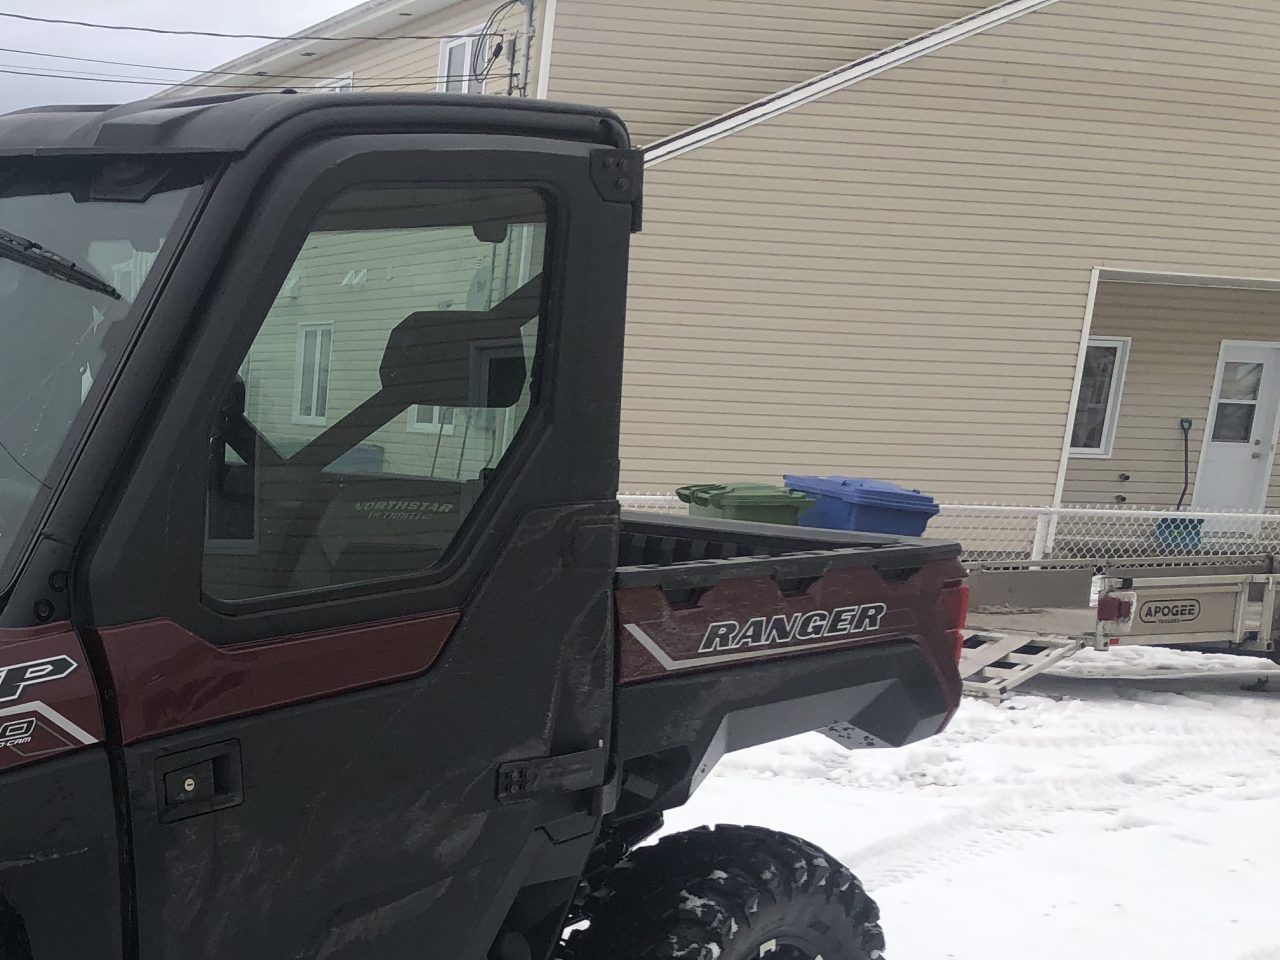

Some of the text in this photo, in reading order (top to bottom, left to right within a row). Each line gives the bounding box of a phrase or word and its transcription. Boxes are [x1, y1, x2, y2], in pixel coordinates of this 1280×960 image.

[355, 501, 453, 513] NORTHSTAR
[1144, 604, 1196, 618] APOGEE
[697, 602, 887, 653] RANGER
[6, 736, 32, 746] CAM
